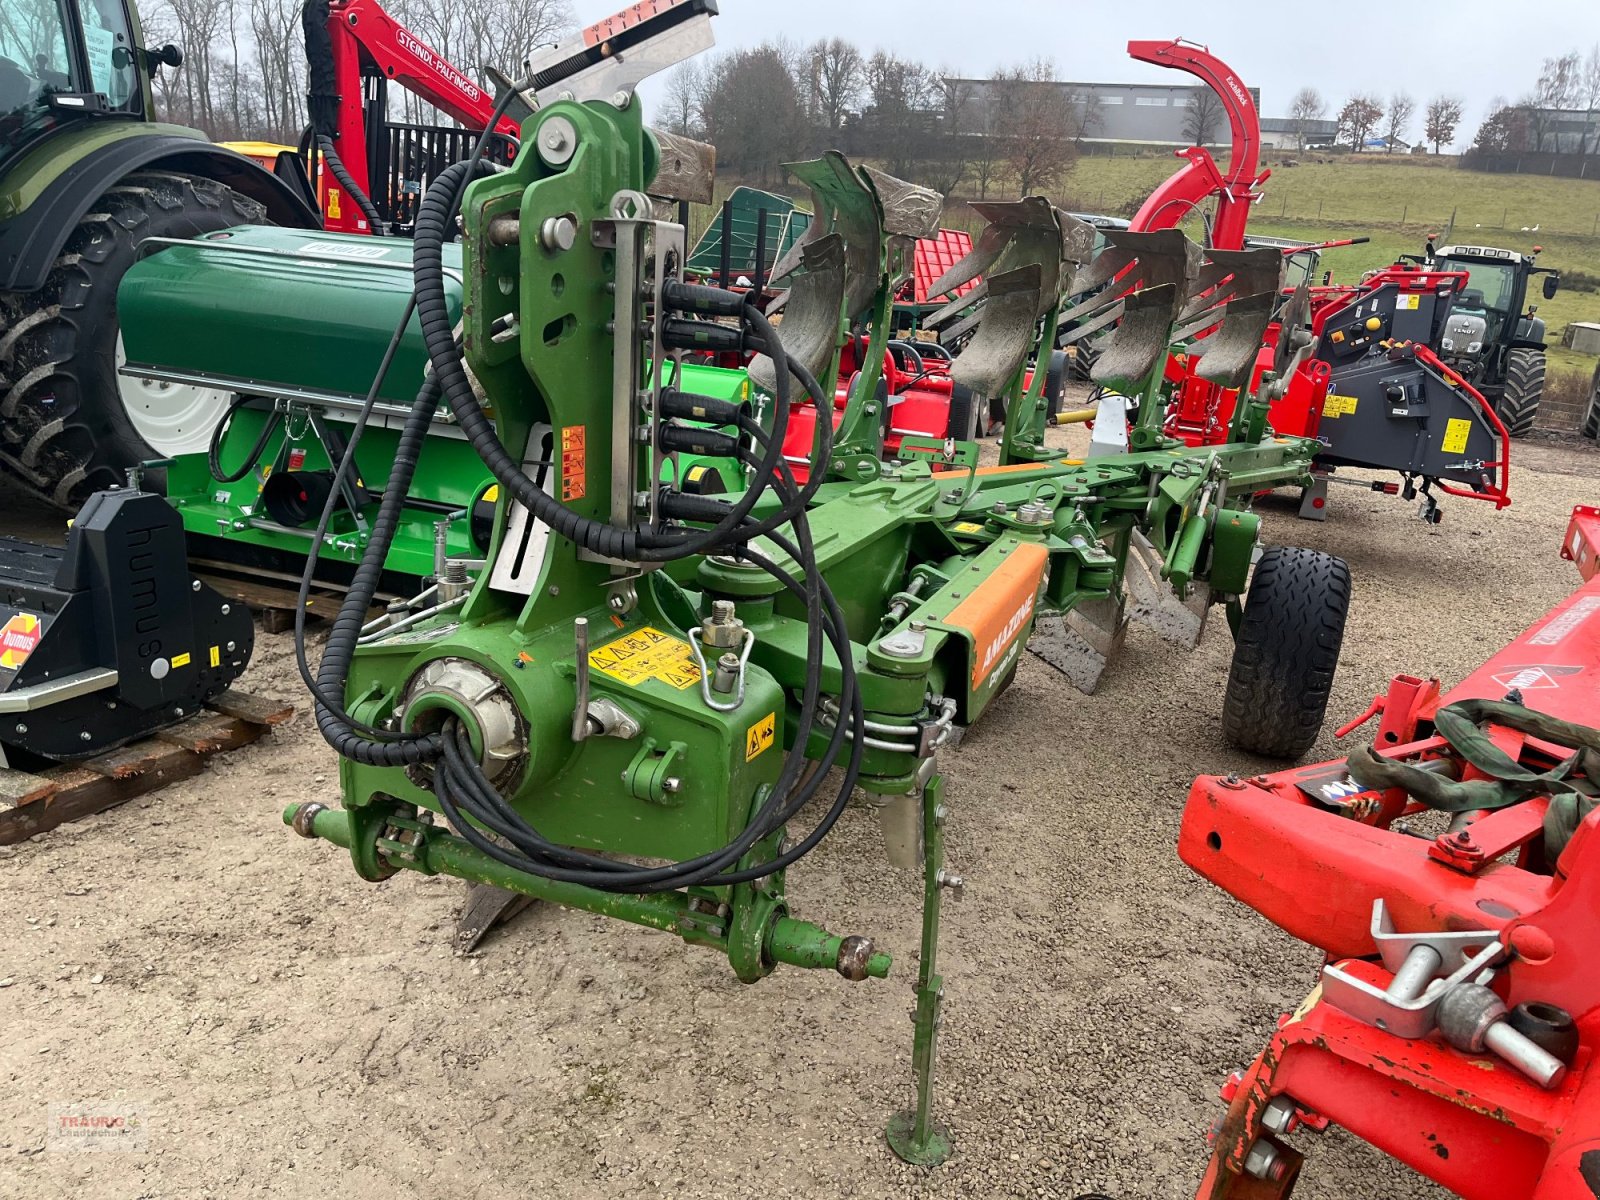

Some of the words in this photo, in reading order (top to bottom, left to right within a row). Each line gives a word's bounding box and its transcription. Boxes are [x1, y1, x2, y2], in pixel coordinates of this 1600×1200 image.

[617, 11, 627, 19] 40
[398, 31, 479, 100] STEINDL-PALFINGER
[126, 525, 169, 658] humus
[3, 630, 35, 650] humus
[982, 592, 1034, 673] AMAZONE
